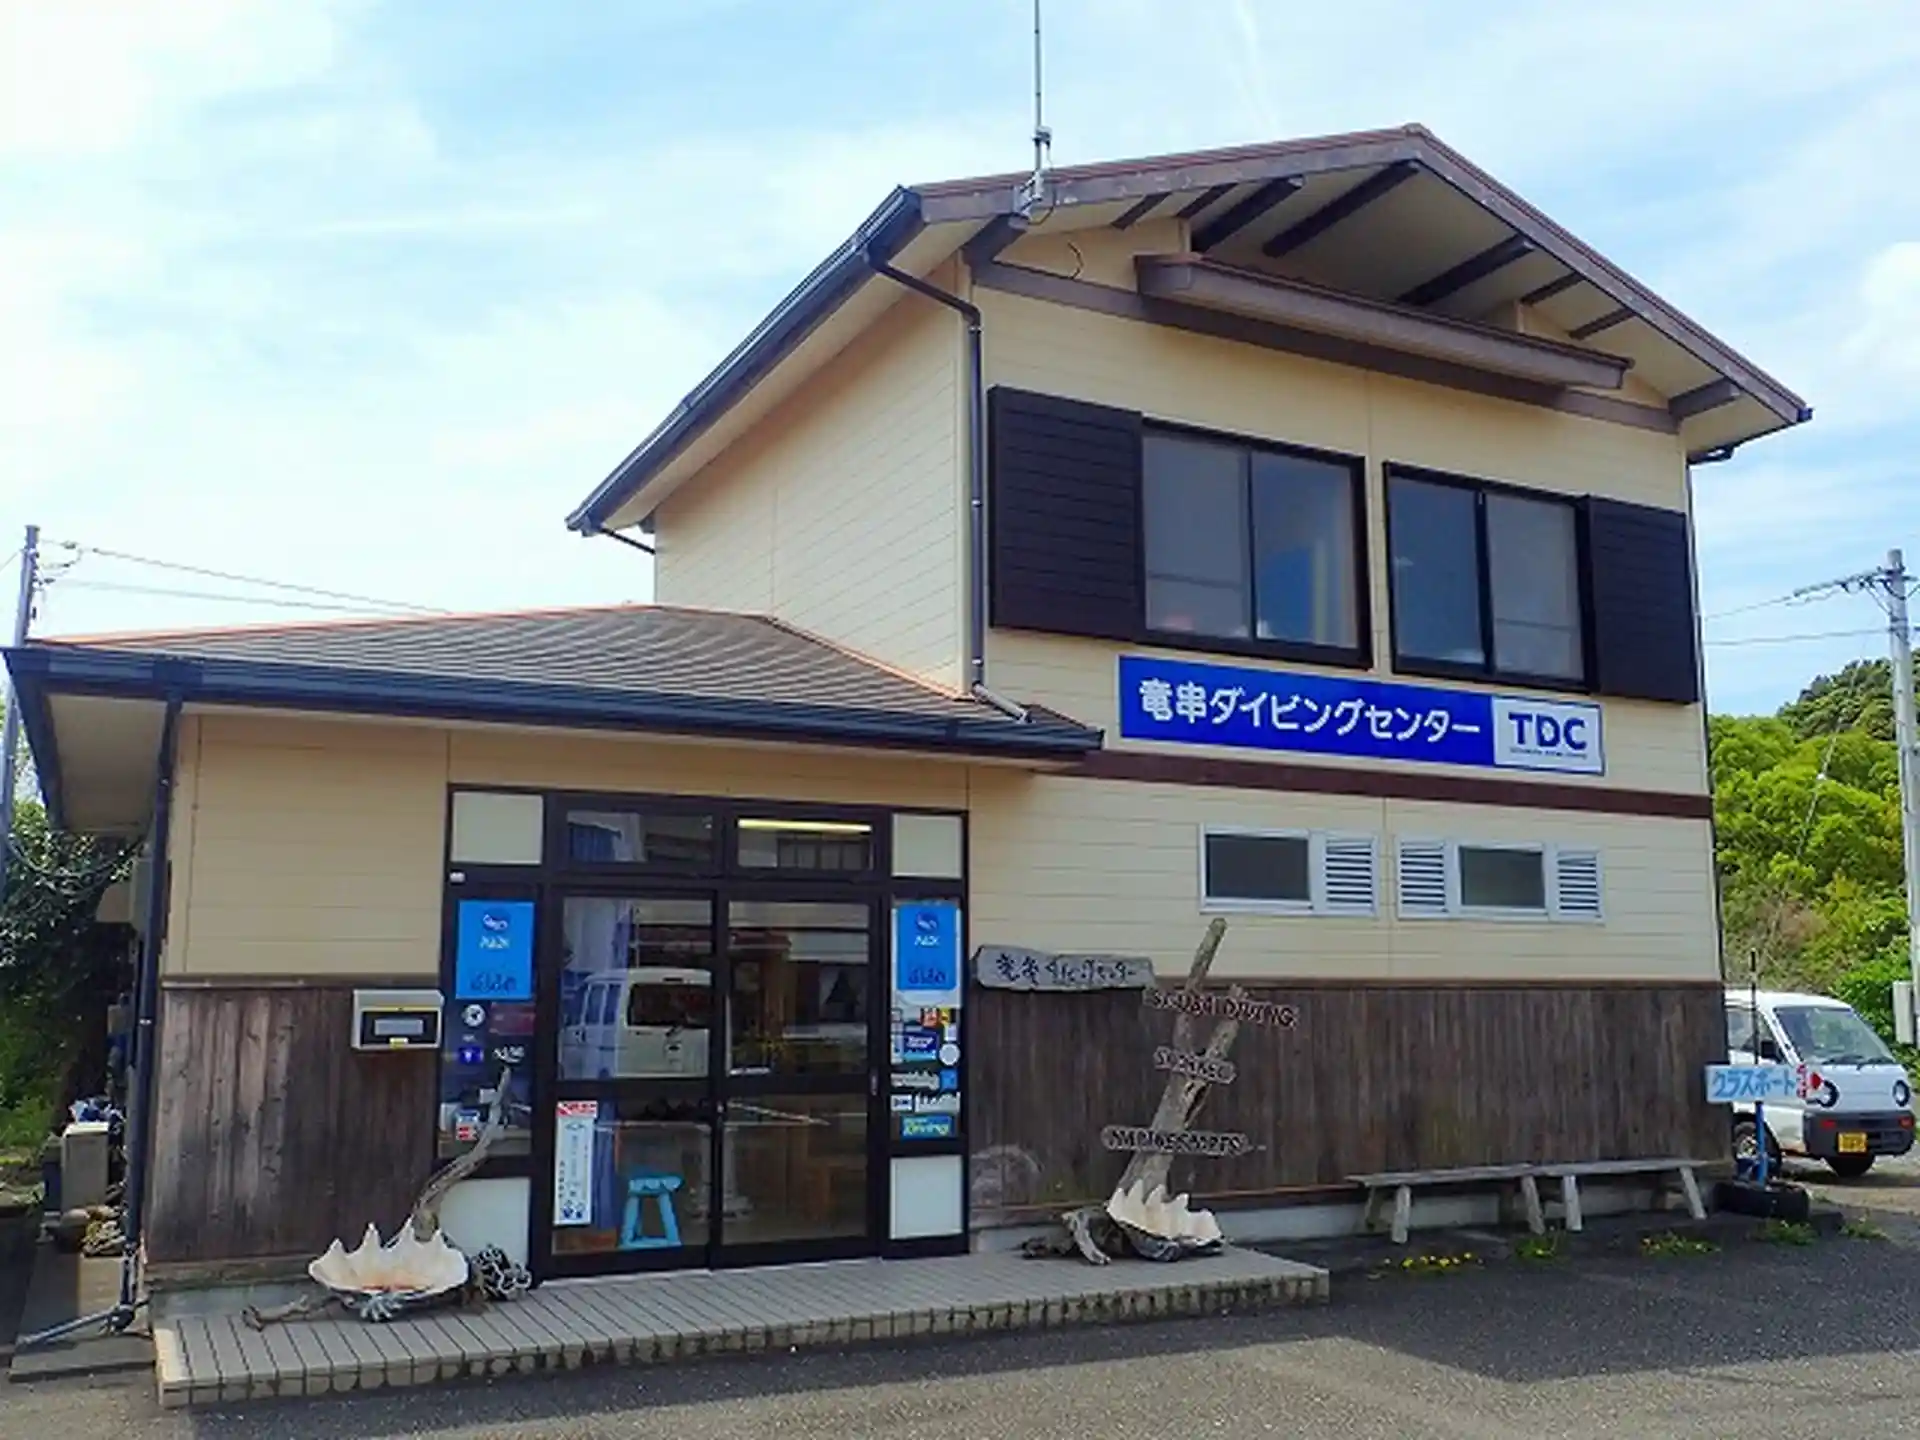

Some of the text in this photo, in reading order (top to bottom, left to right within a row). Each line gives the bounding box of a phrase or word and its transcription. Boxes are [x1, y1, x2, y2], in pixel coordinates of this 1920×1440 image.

[1139, 678, 1480, 742] 竜串ダイビングセンター
[1508, 712, 1587, 751] TDC
